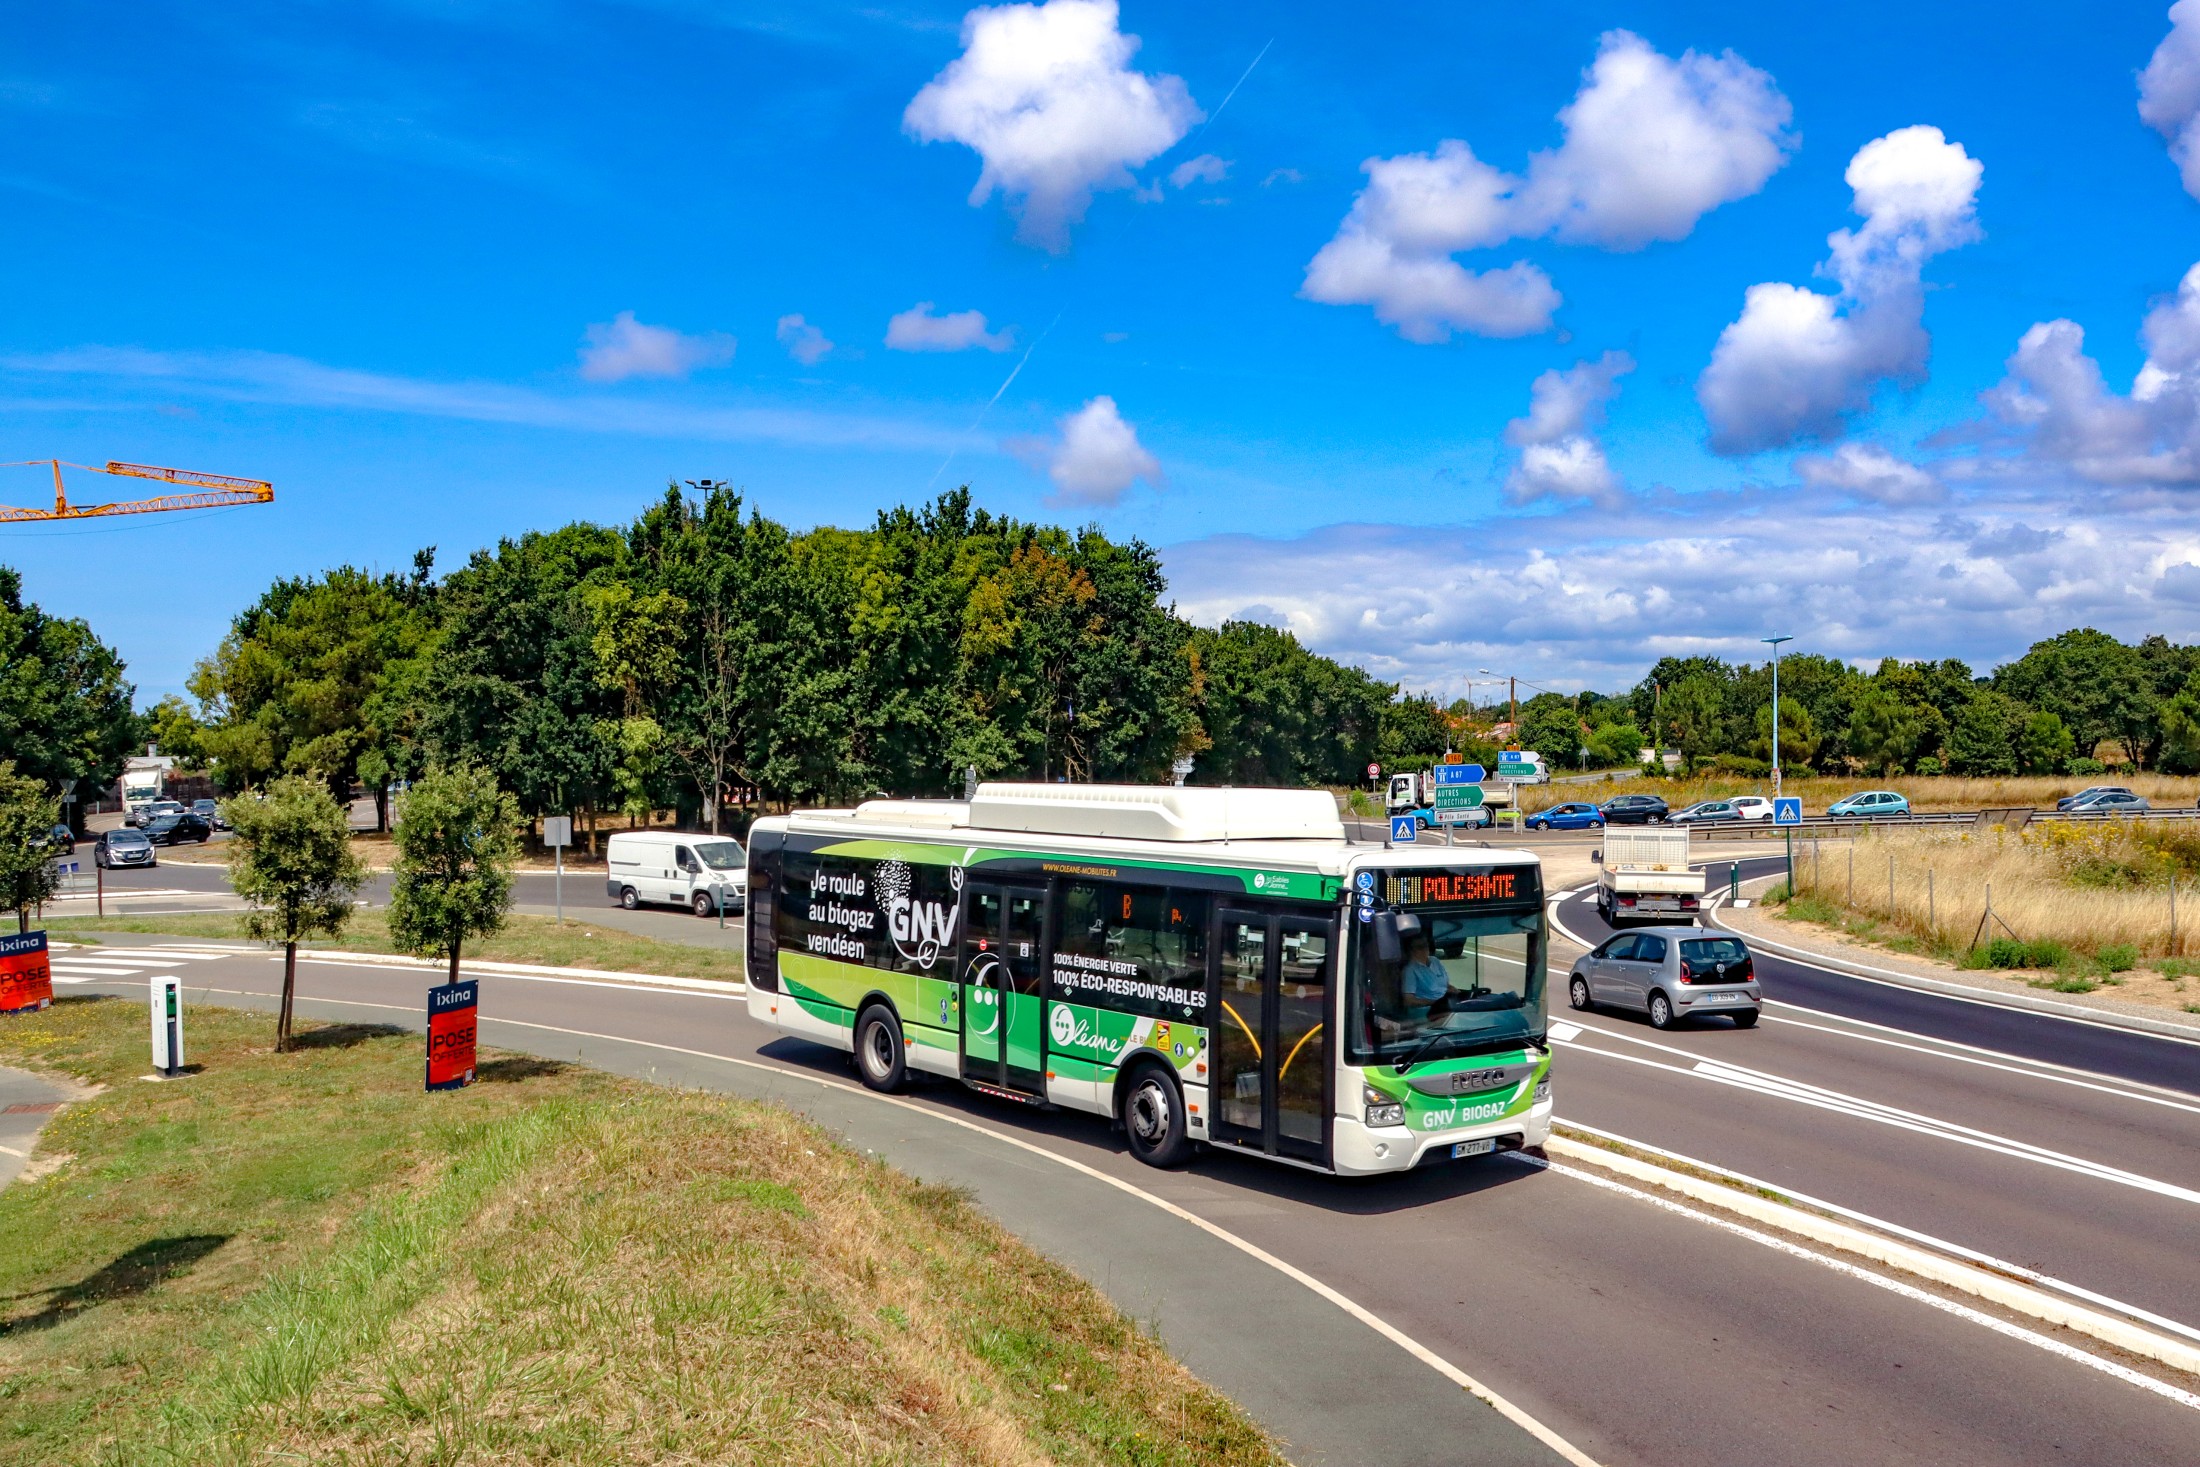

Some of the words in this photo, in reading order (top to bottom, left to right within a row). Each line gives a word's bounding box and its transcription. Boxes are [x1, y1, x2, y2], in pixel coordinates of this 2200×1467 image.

[1451, 754, 1461, 762] 160
[1437, 789, 1459, 798] AUTRES
[1437, 798, 1472, 807] DIRECTIONS
[1457, 812, 1470, 820] Santé
[1042, 863, 1118, 878] WWW.OLEANE-MOBILITES.FR
[810, 869, 828, 892] Je
[829, 873, 865, 897] roule
[808, 904, 826, 923] au
[828, 901, 875, 933] biogaz
[888, 897, 959, 947] GNV
[0, 937, 39, 952] ixina
[807, 933, 865, 960] vendéen
[1053, 953, 1073, 966] 100%
[1073, 953, 1109, 972] ÉNERGIE
[1109, 961, 1138, 976] VERTE
[0, 966, 48, 985] POSE
[1053, 969, 1079, 987] 100%
[1, 981, 49, 995] OFFERTE
[436, 989, 471, 1007] ixina
[433, 1027, 475, 1051] POSE
[1130, 1034, 1137, 1043] LE
[432, 1044, 474, 1063] OFFERTE
[1451, 1067, 1505, 1091] IVECO
[1423, 1108, 1456, 1128] GNV
[1462, 1101, 1506, 1122] BIOGAZ
